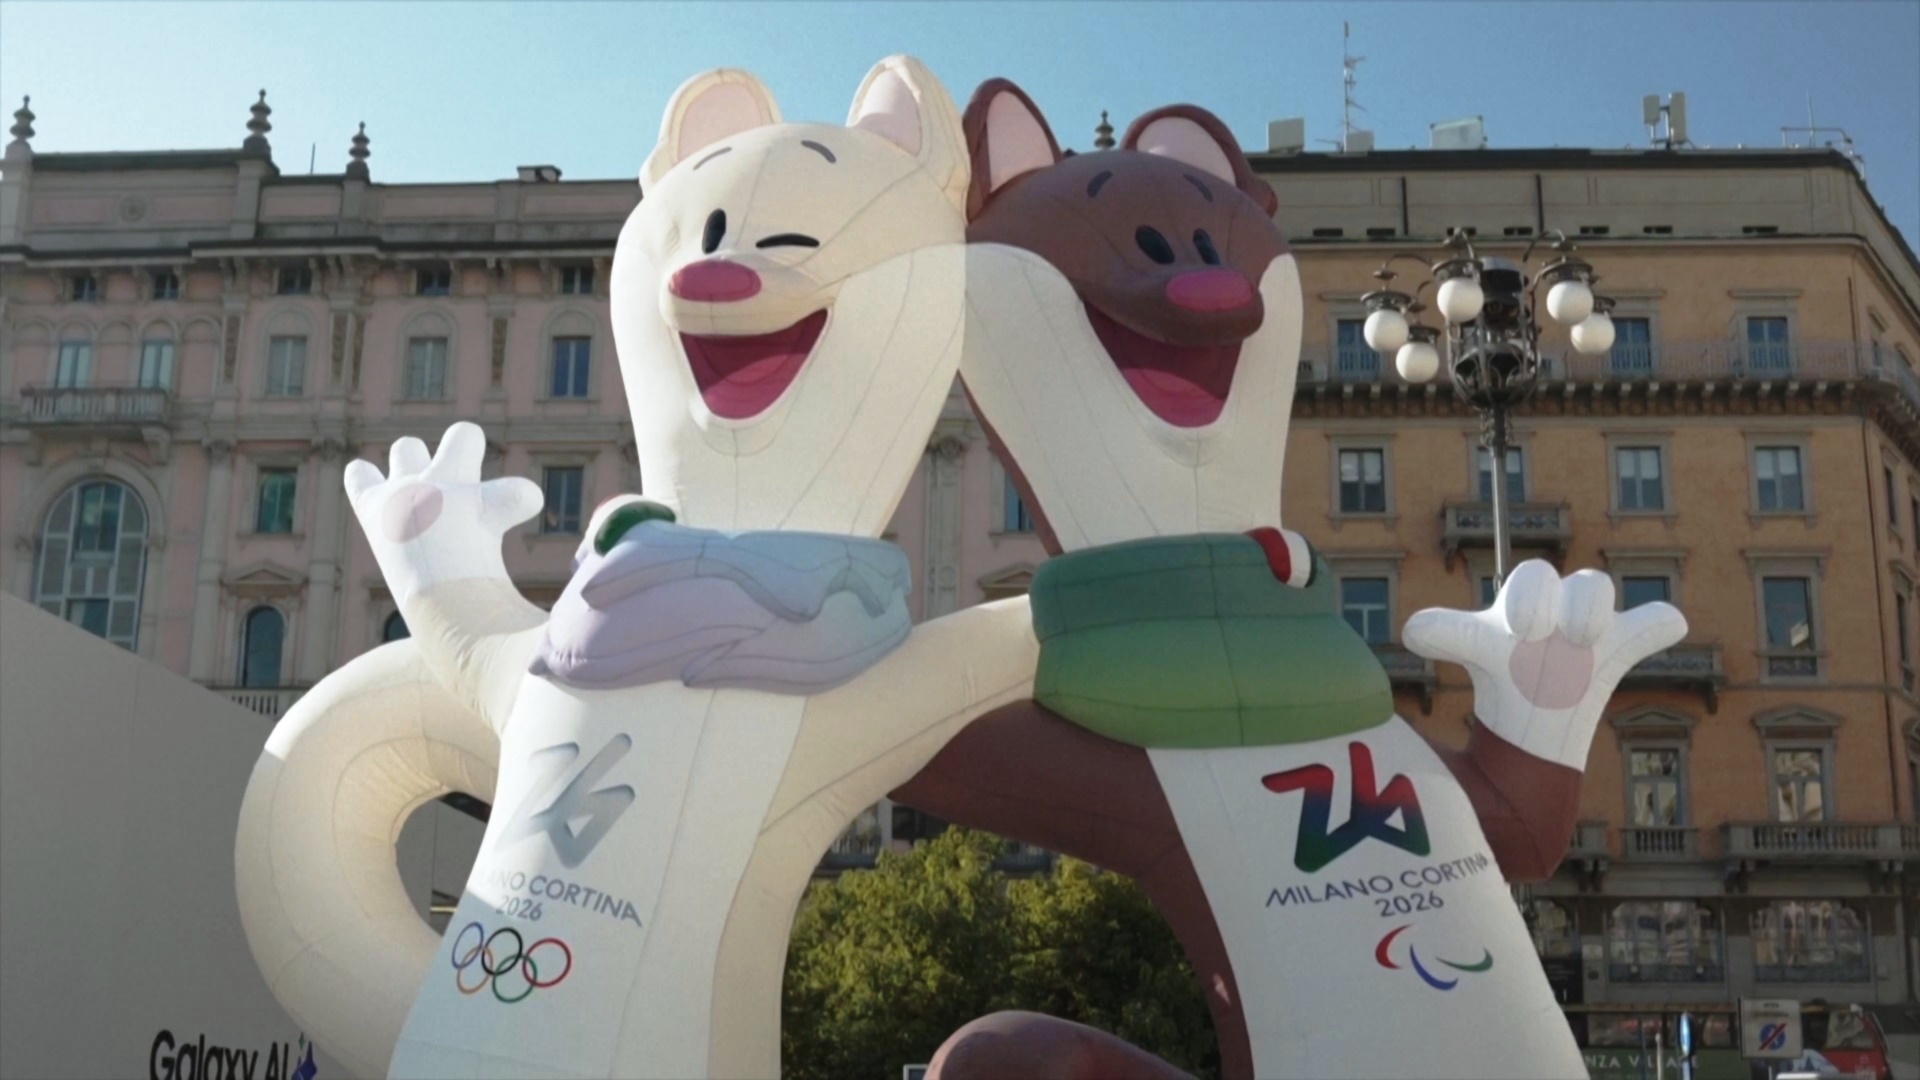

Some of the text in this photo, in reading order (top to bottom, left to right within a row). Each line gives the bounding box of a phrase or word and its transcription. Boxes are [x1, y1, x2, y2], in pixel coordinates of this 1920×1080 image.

[529, 874, 642, 928] CORTINA
[1266, 875, 1393, 908] MILANO
[1374, 891, 1445, 917] 2026
[496, 896, 543, 922] 2026
